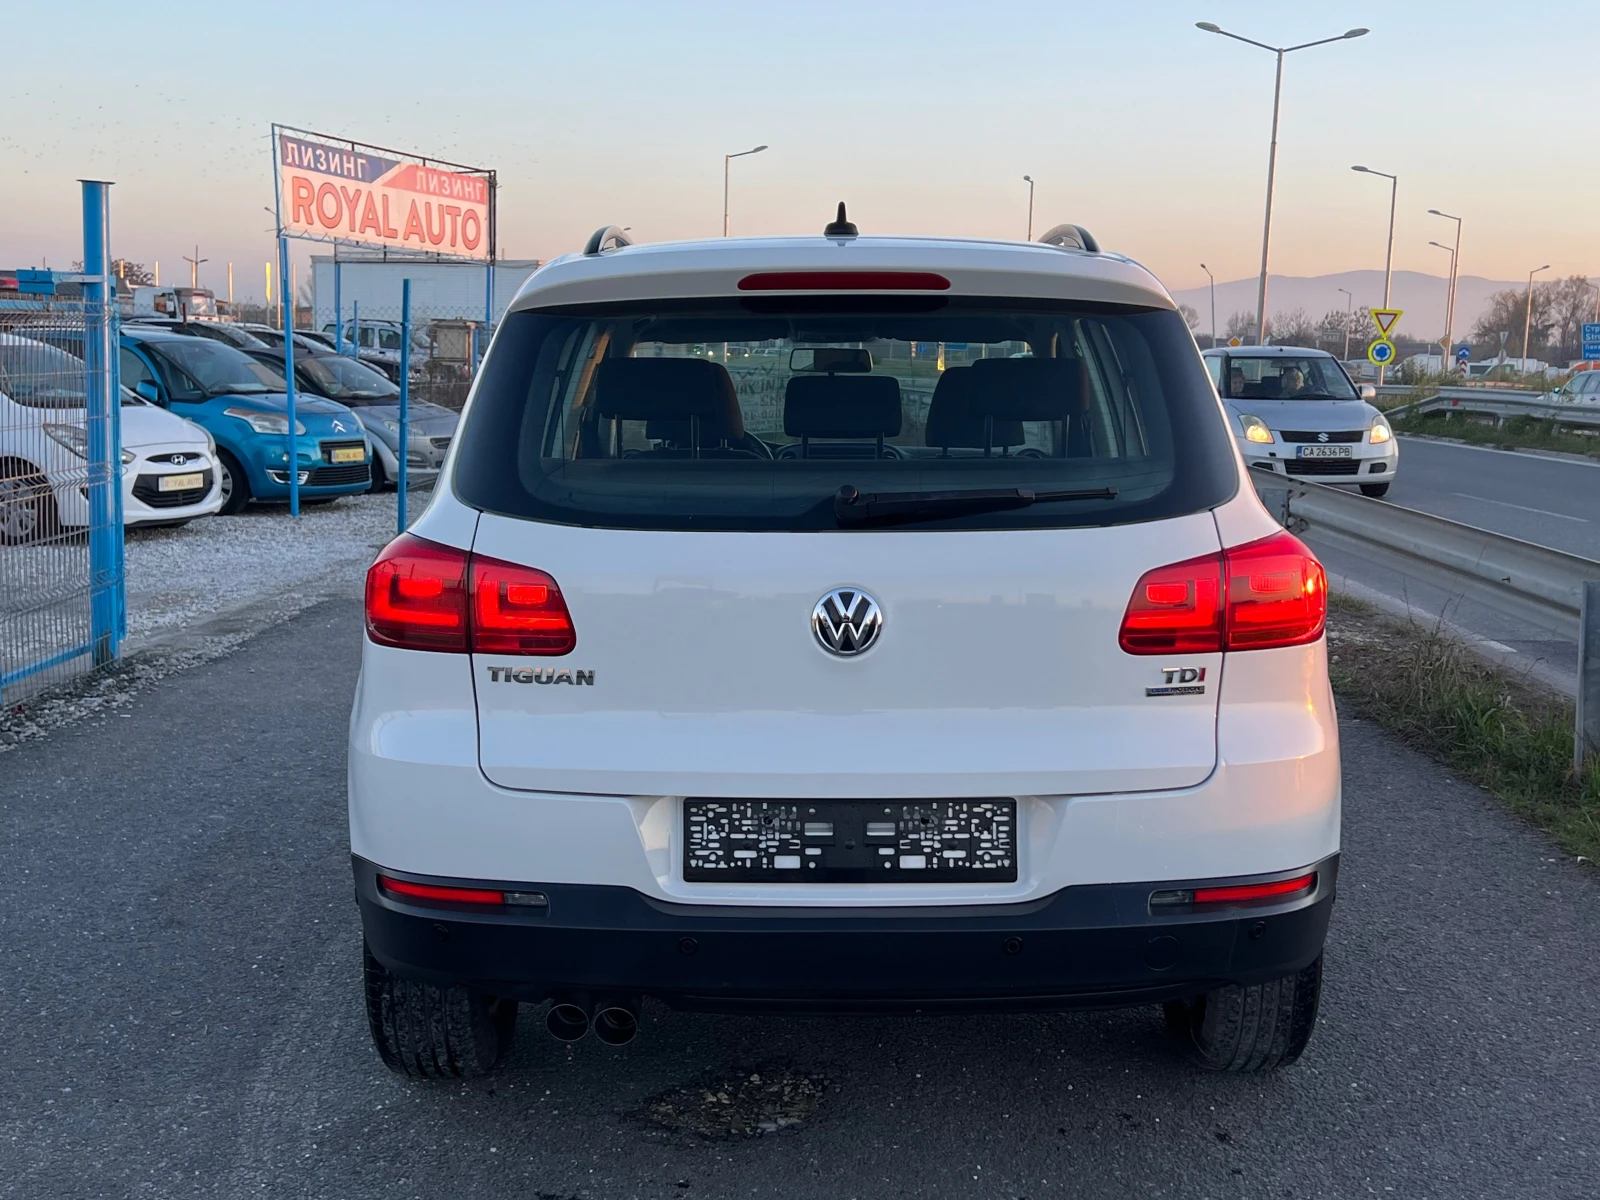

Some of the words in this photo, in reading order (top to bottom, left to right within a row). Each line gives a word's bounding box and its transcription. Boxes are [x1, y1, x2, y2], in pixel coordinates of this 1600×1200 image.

[286, 141, 367, 179] ЛИЗИНГ
[416, 170, 484, 201] ЛИЗИНГ
[291, 175, 399, 239] ROYAL
[403, 198, 482, 251] AUTO
[1585, 325, 1600, 333] Стр
[1303, 447, 1314, 457] CA
[1338, 447, 1350, 457] PB
[487, 666, 595, 686] TIGUAN
[1161, 666, 1206, 684] TDI
